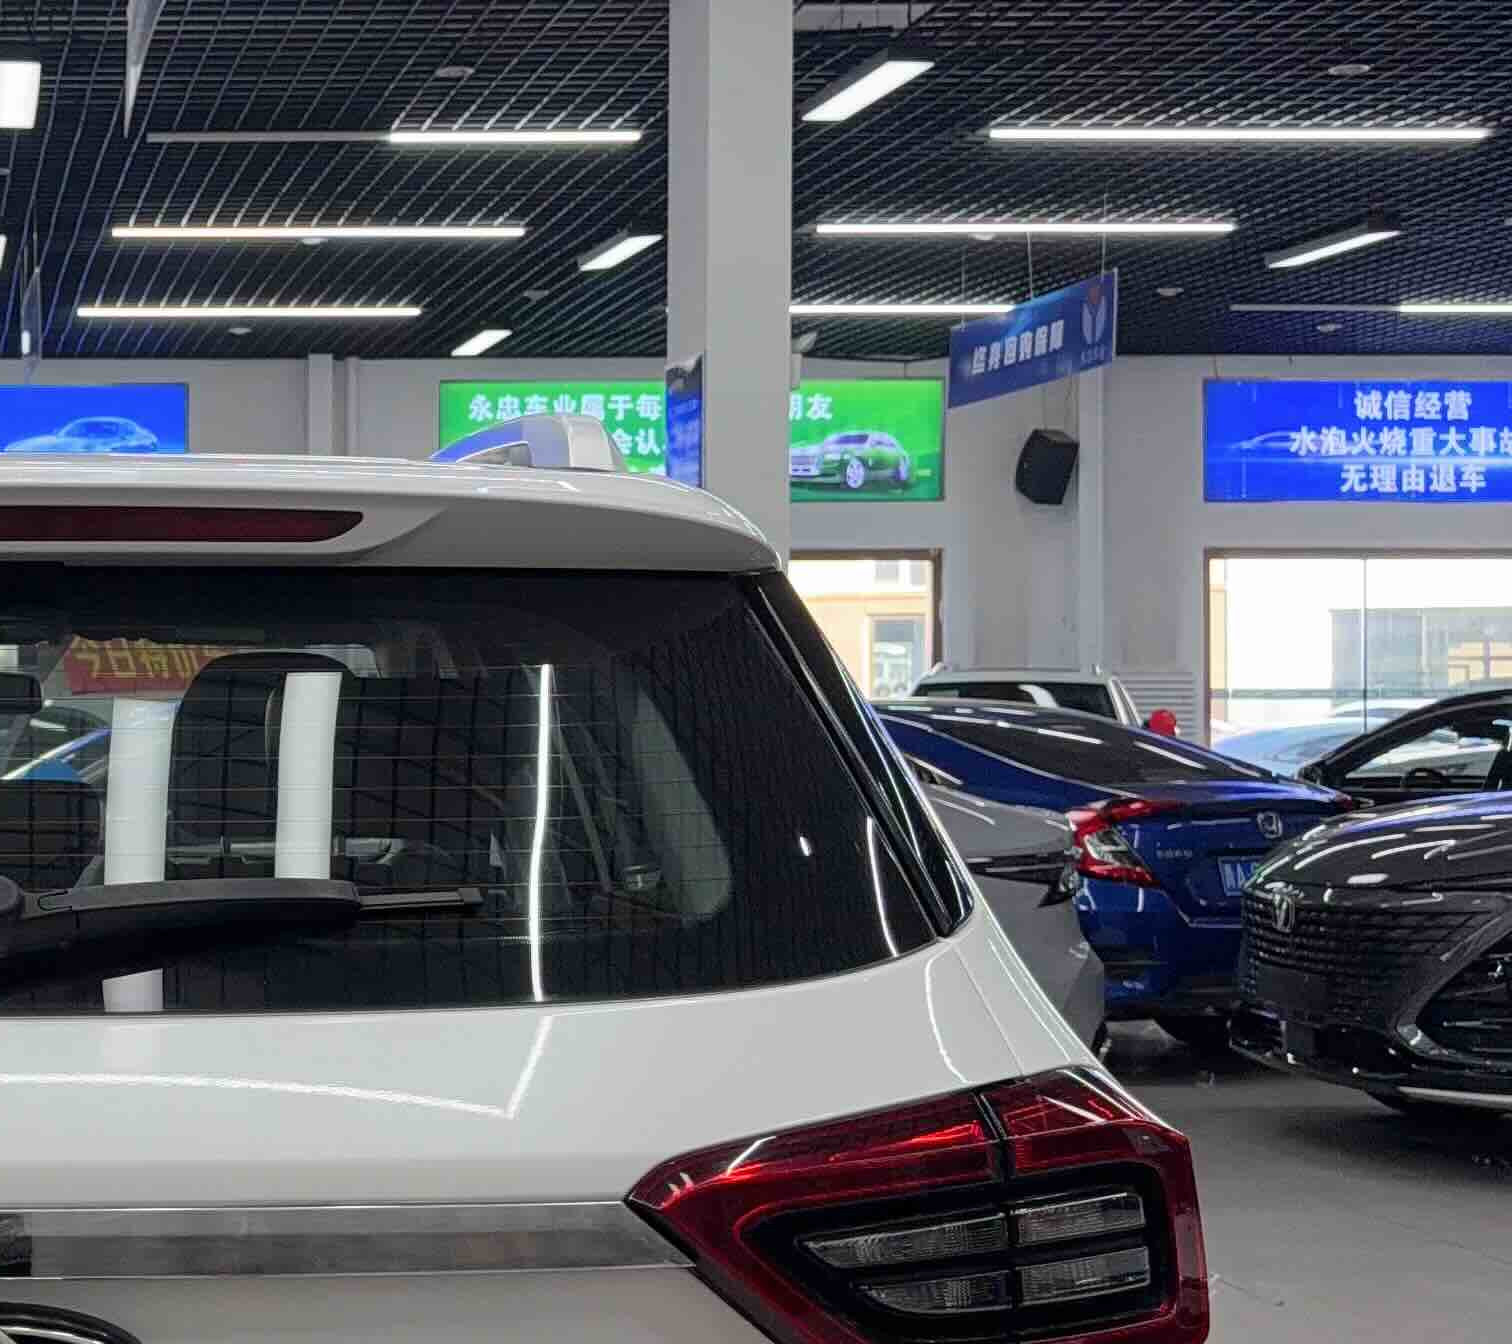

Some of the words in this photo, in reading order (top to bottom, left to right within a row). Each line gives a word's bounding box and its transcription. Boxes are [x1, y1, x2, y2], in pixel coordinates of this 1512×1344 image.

[1354, 390, 1472, 421] 诚信经营
[1340, 463, 1486, 494] 无理由退车
[70, 633, 223, 679] 今日特价
